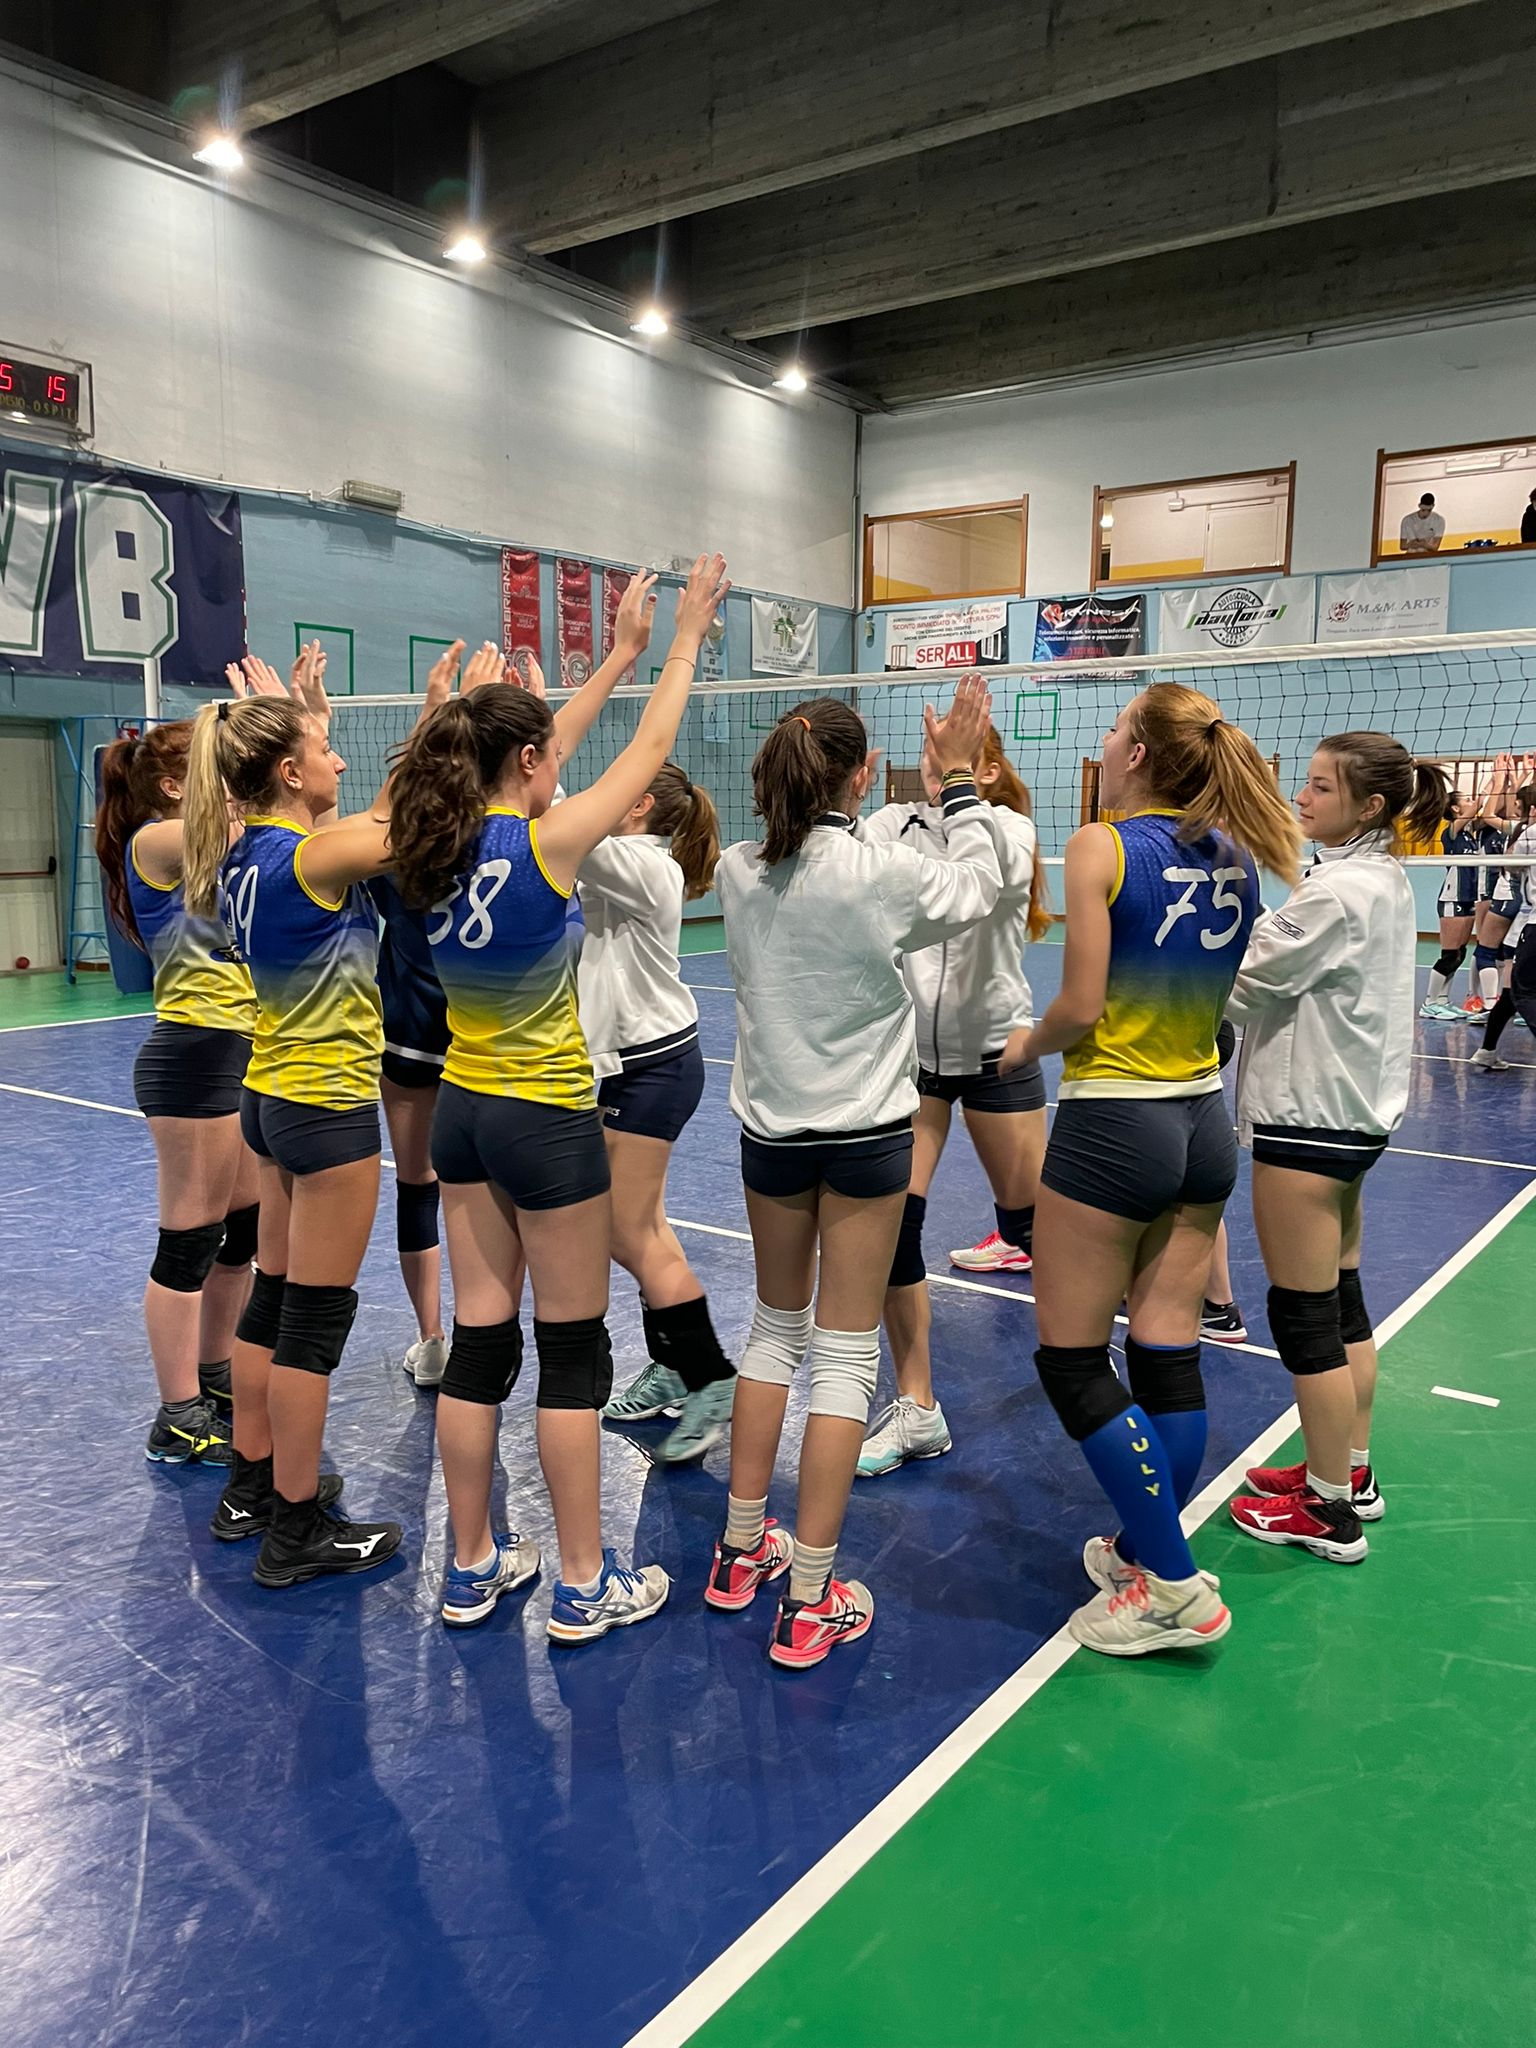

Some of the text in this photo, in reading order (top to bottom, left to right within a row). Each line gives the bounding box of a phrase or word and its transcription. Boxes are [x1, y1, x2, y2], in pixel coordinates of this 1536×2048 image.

[47, 375, 67, 402] 15
[501, 547, 513, 669] ONZABRIANZA
[1217, 591, 1257, 609] AUTOSCUOLA
[1401, 597, 1441, 610] ARTS
[1154, 866, 1248, 950] 75
